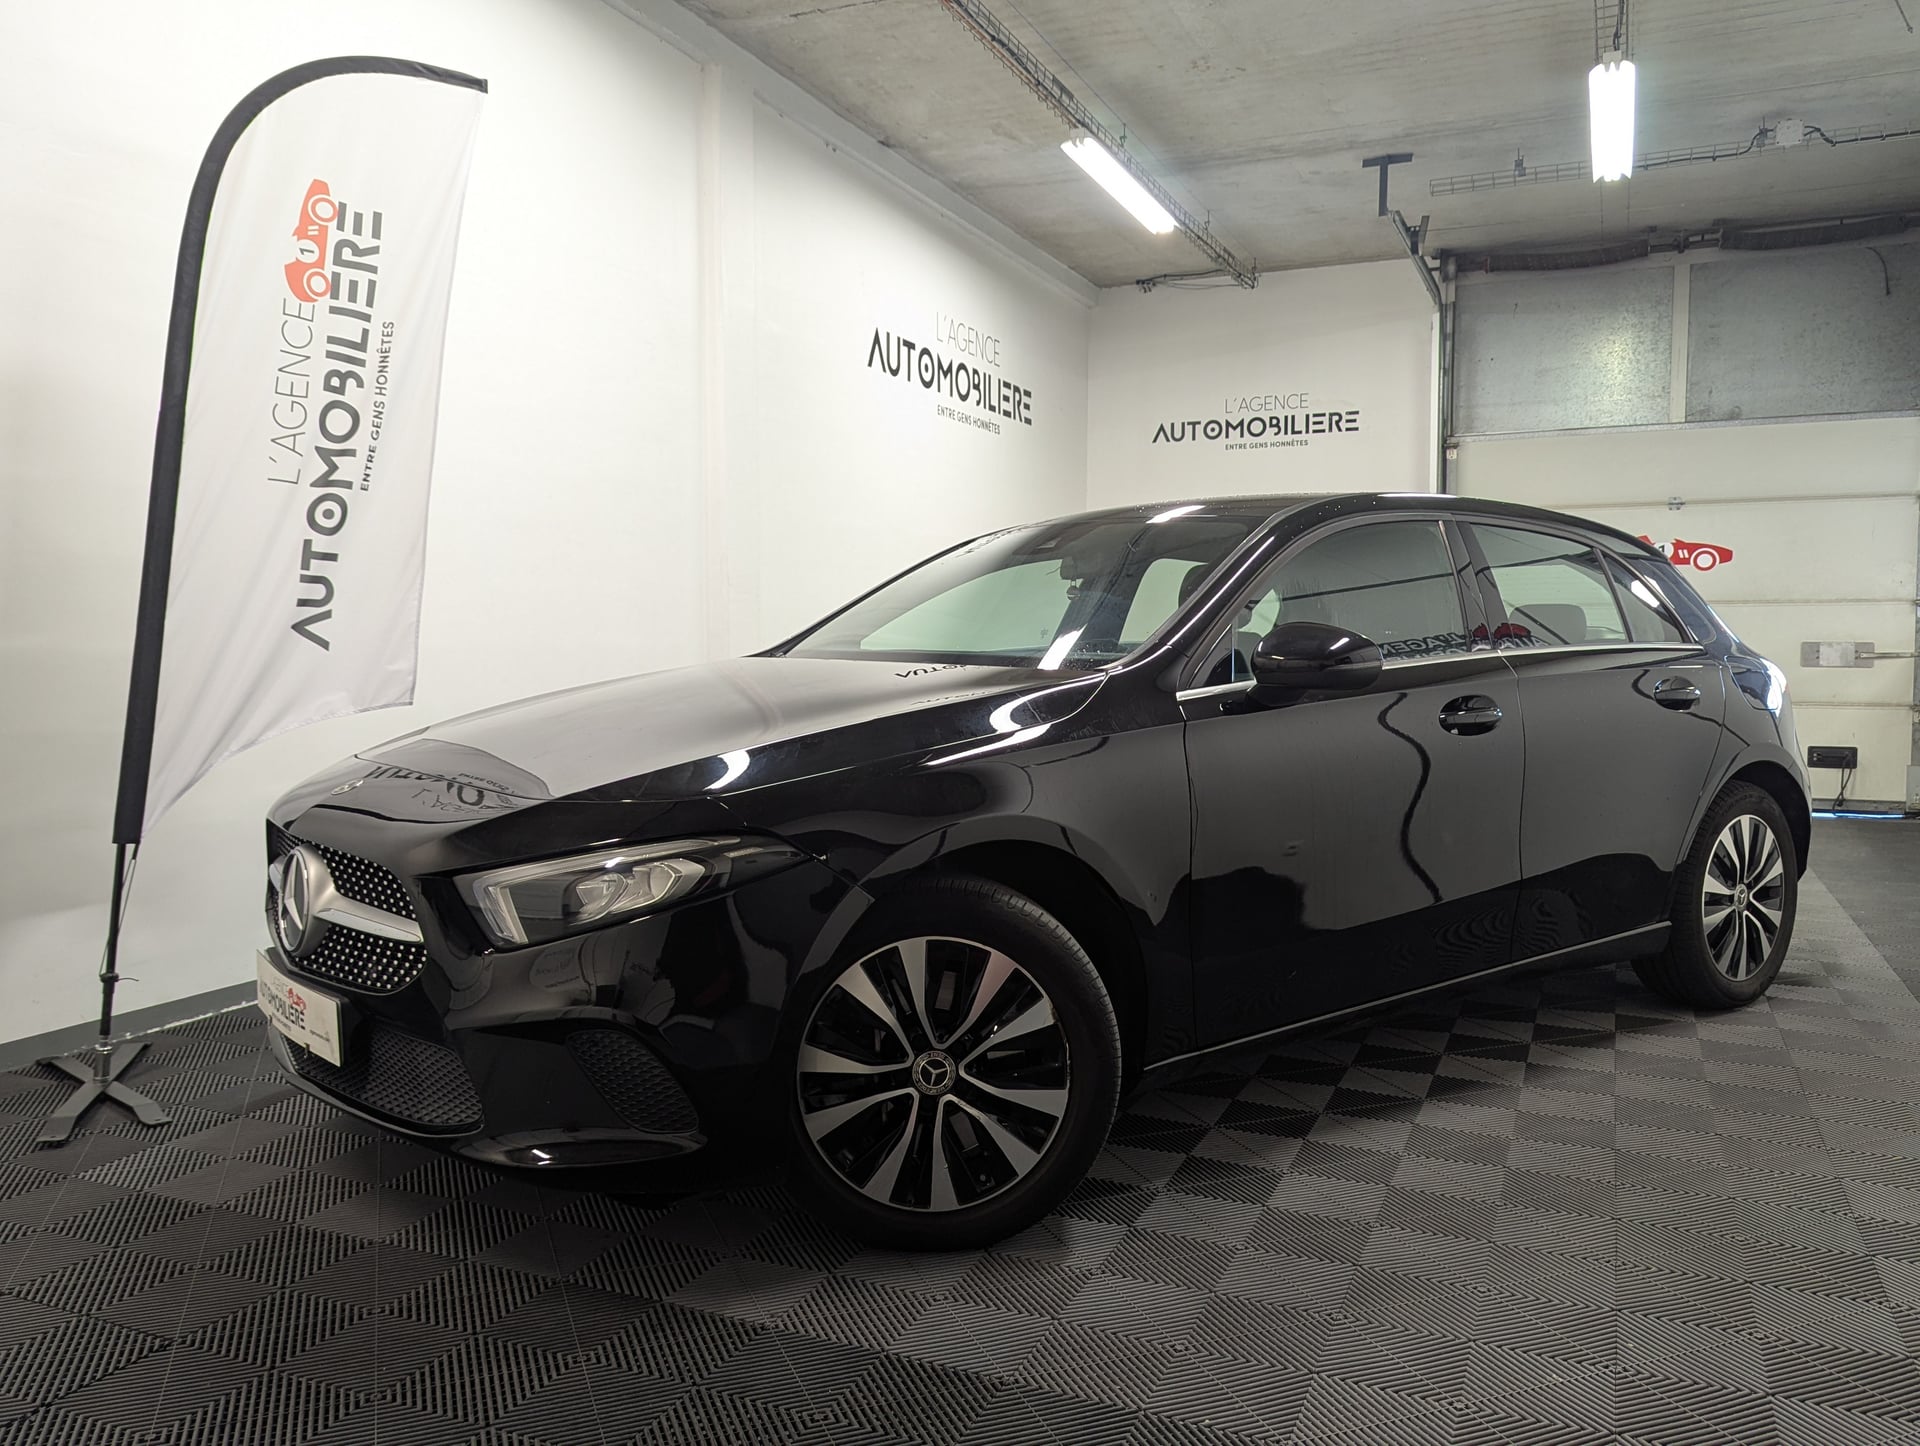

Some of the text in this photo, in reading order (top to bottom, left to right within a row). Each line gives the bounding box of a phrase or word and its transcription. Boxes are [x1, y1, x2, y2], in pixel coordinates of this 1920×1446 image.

[299, 247, 315, 256] 1
[936, 311, 1001, 368] L'AGENCE
[267, 298, 315, 485] L'AGENCE
[867, 327, 1032, 426] AUTOMOBILIERE
[290, 201, 382, 651] AUTOMOBILIERE
[360, 321, 395, 492] ENTRE GENS HONNÊTES
[937, 404, 956, 420] ENTRE
[957, 411, 972, 426] GENS
[1225, 393, 1310, 414] L'AGENCE
[1152, 410, 1360, 443] AUTOMOBILIERE
[1225, 442, 1248, 451] ENTRE
[1249, 441, 1269, 449] GENS
